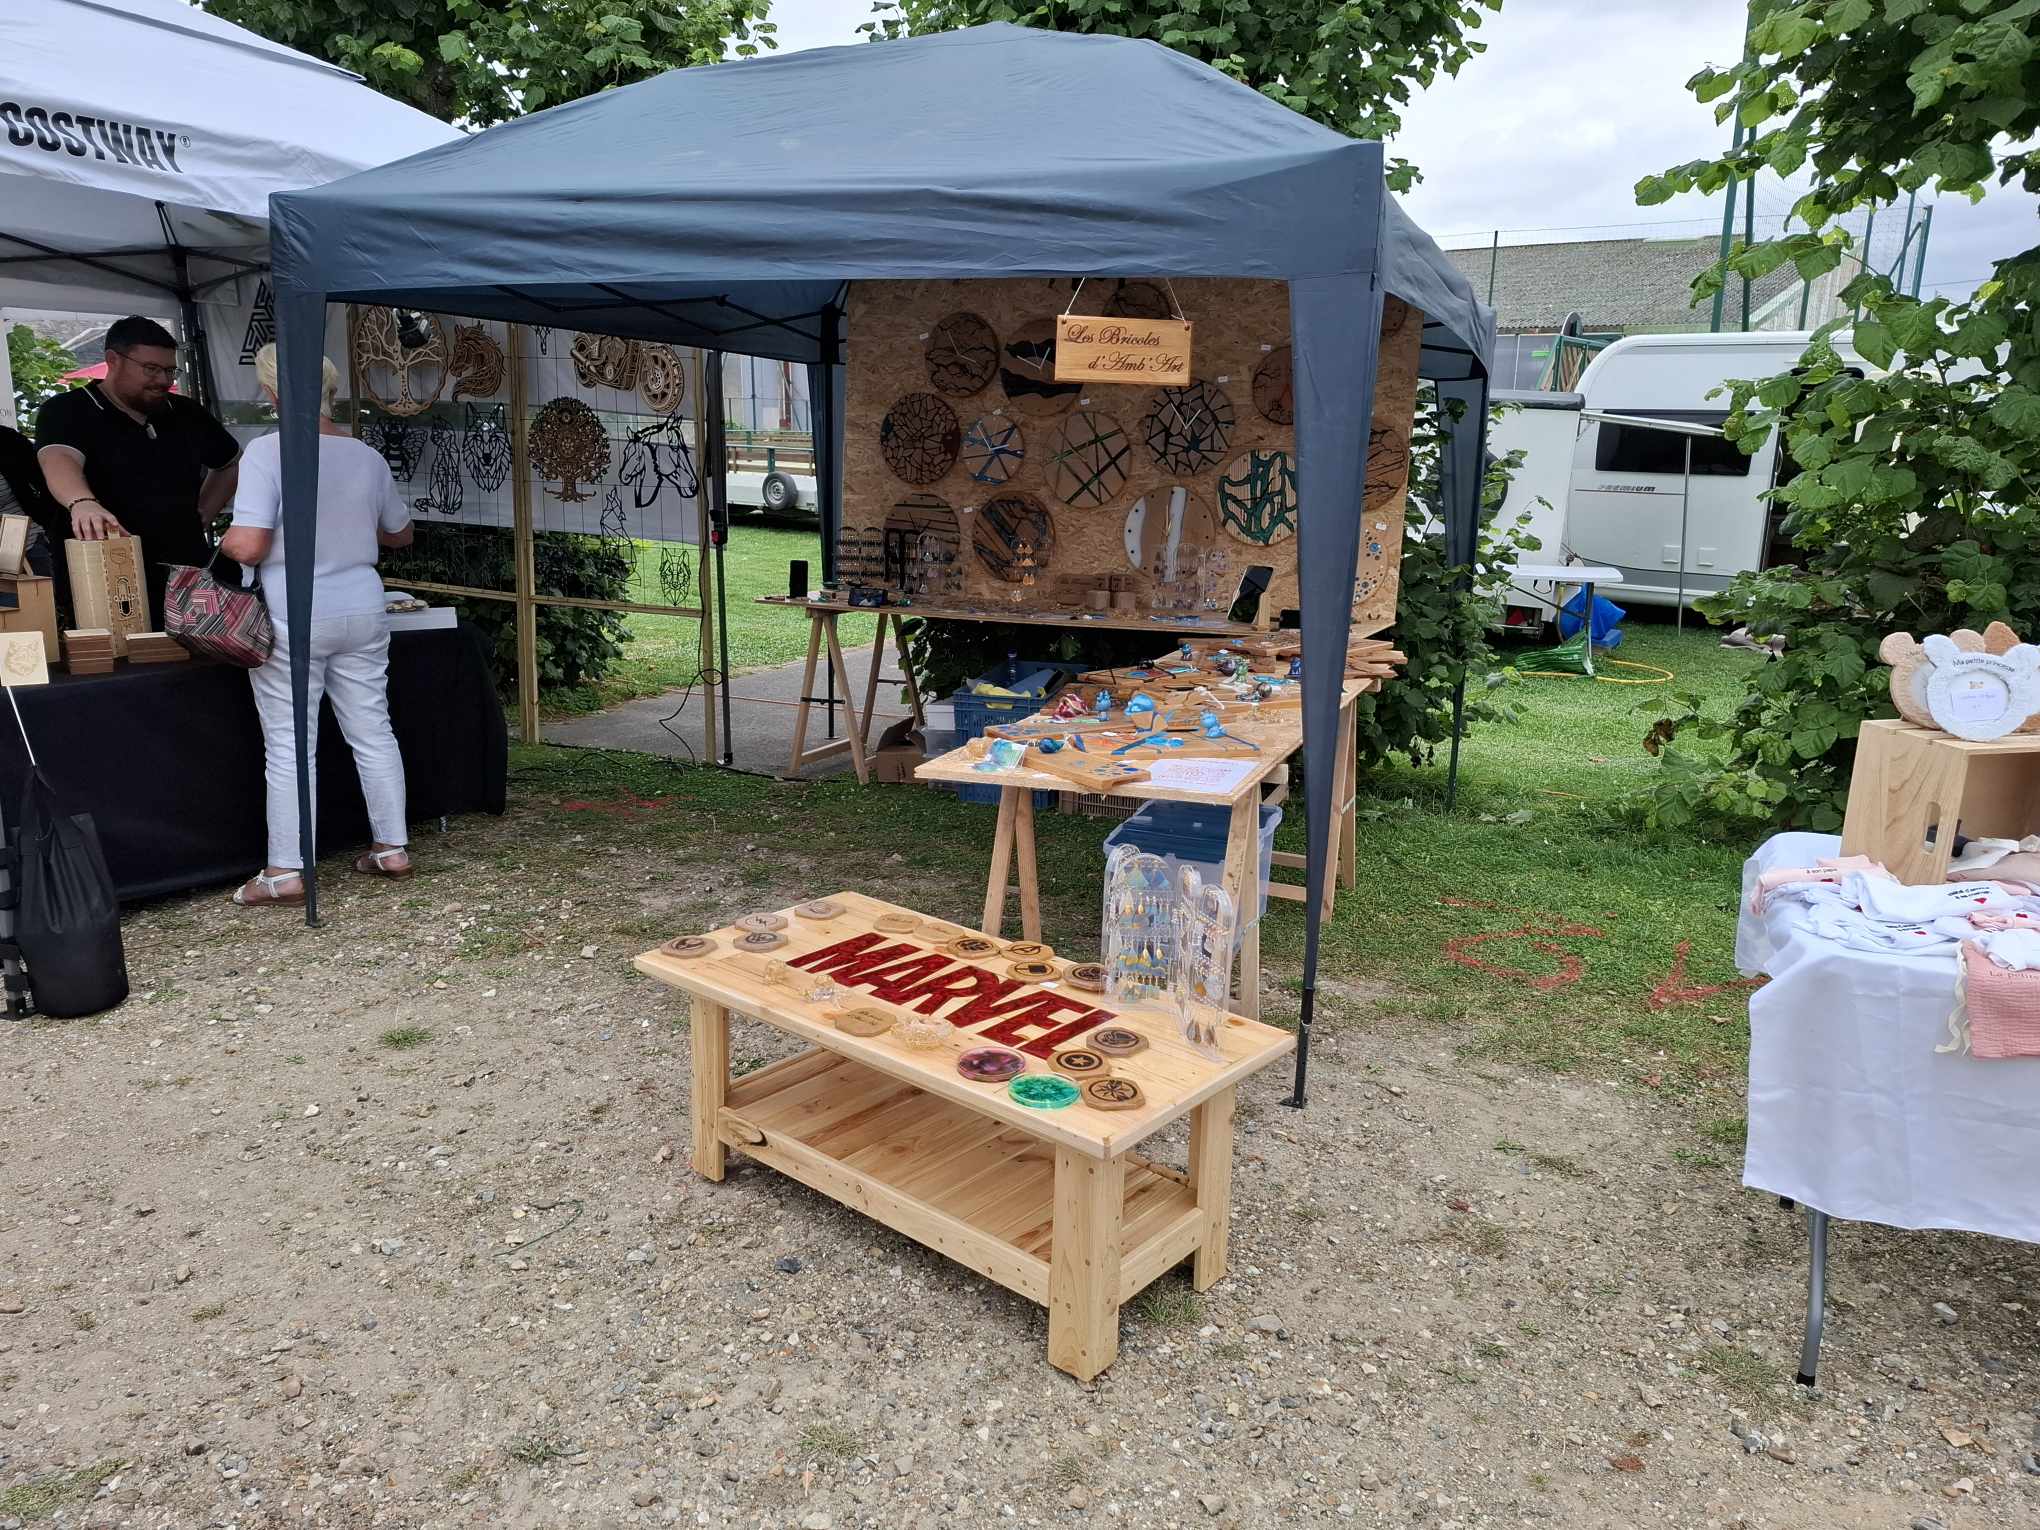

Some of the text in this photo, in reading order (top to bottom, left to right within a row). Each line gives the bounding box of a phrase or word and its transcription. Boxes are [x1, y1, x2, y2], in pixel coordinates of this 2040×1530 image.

[1064, 324, 1161, 346] Les Bricoles
[786, 932, 1119, 1061] MARVEL
